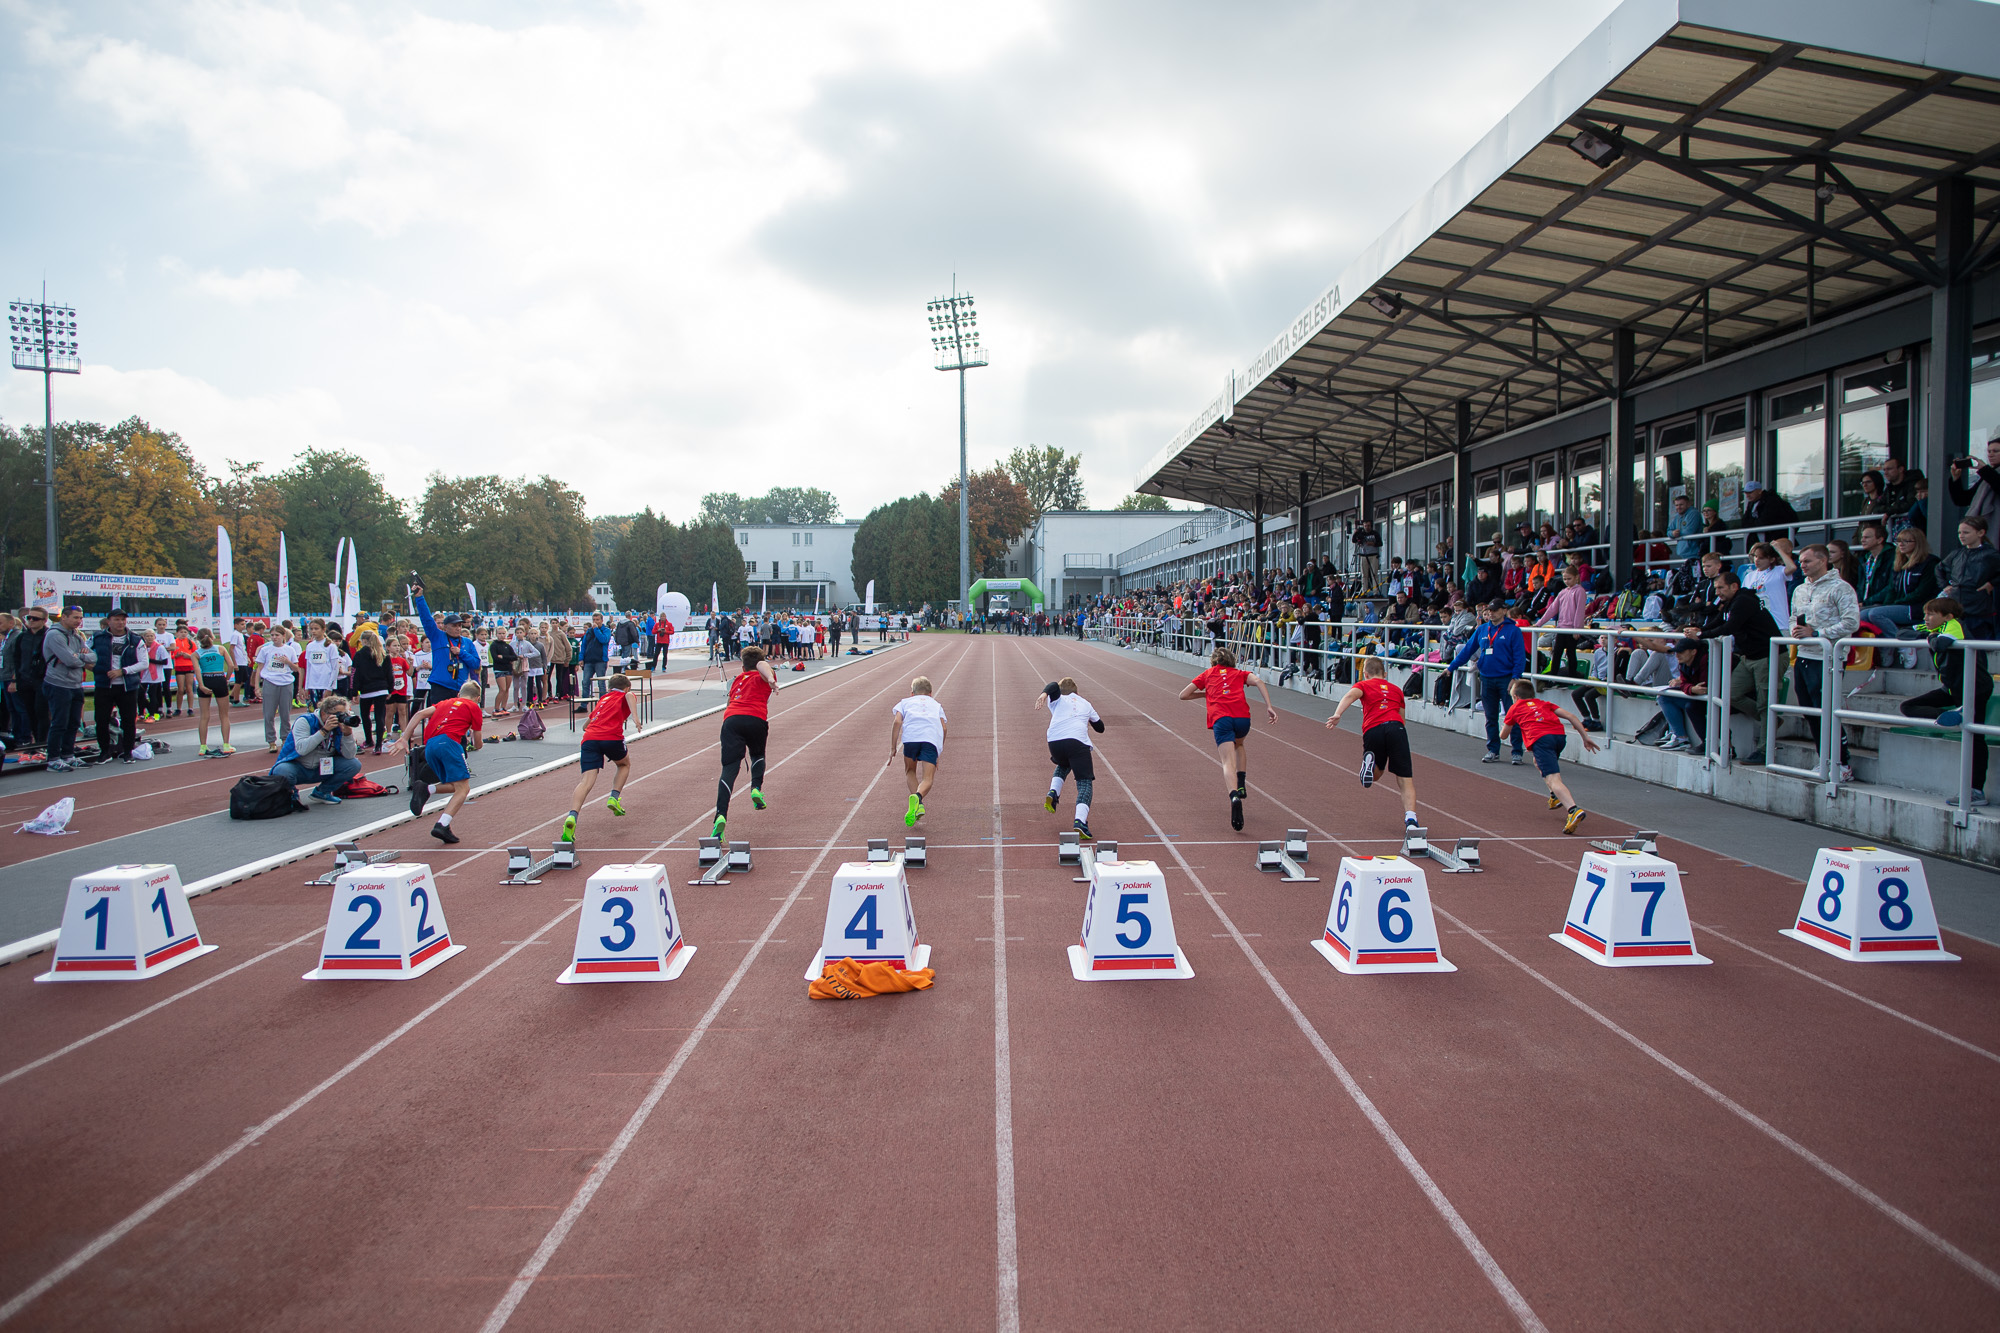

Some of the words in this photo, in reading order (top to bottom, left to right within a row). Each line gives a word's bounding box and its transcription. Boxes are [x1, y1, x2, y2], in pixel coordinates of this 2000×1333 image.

[1248, 333, 1290, 386] ZYGMUNTA
[1292, 284, 1341, 347] SZELESTA
[71, 574, 124, 583] LEKKOATLETYCZNE
[124, 577, 149, 585] NADZIEJE
[149, 578, 180, 586] OLIMPIJSKIE
[92, 884, 121, 893] polanik
[150, 873, 171, 887] polanik
[356, 883, 386, 892] polanik
[411, 873, 426, 886] polanik
[609, 885, 639, 893] polanik
[855, 883, 885, 892] polanik
[1122, 881, 1152, 890] polanik
[1384, 876, 1413, 885] polanik
[1592, 863, 1608, 874] polanik
[1637, 870, 1666, 879] polanik
[1829, 859, 1851, 871] polanik
[1881, 865, 1910, 874] polanik
[151, 887, 175, 938] 1
[410, 887, 435, 943] 2
[660, 888, 673, 940] 3
[1115, 894, 1152, 949] 5
[1337, 880, 1353, 933] 6
[1377, 888, 1413, 943] 6
[1582, 871, 1606, 925] 7
[1630, 882, 1666, 936] 7
[1817, 870, 1845, 922] 8
[1877, 877, 1914, 931] 8
[84, 897, 110, 950] 1
[344, 895, 382, 949] 2
[600, 897, 636, 952] 3
[844, 894, 884, 950] 4
